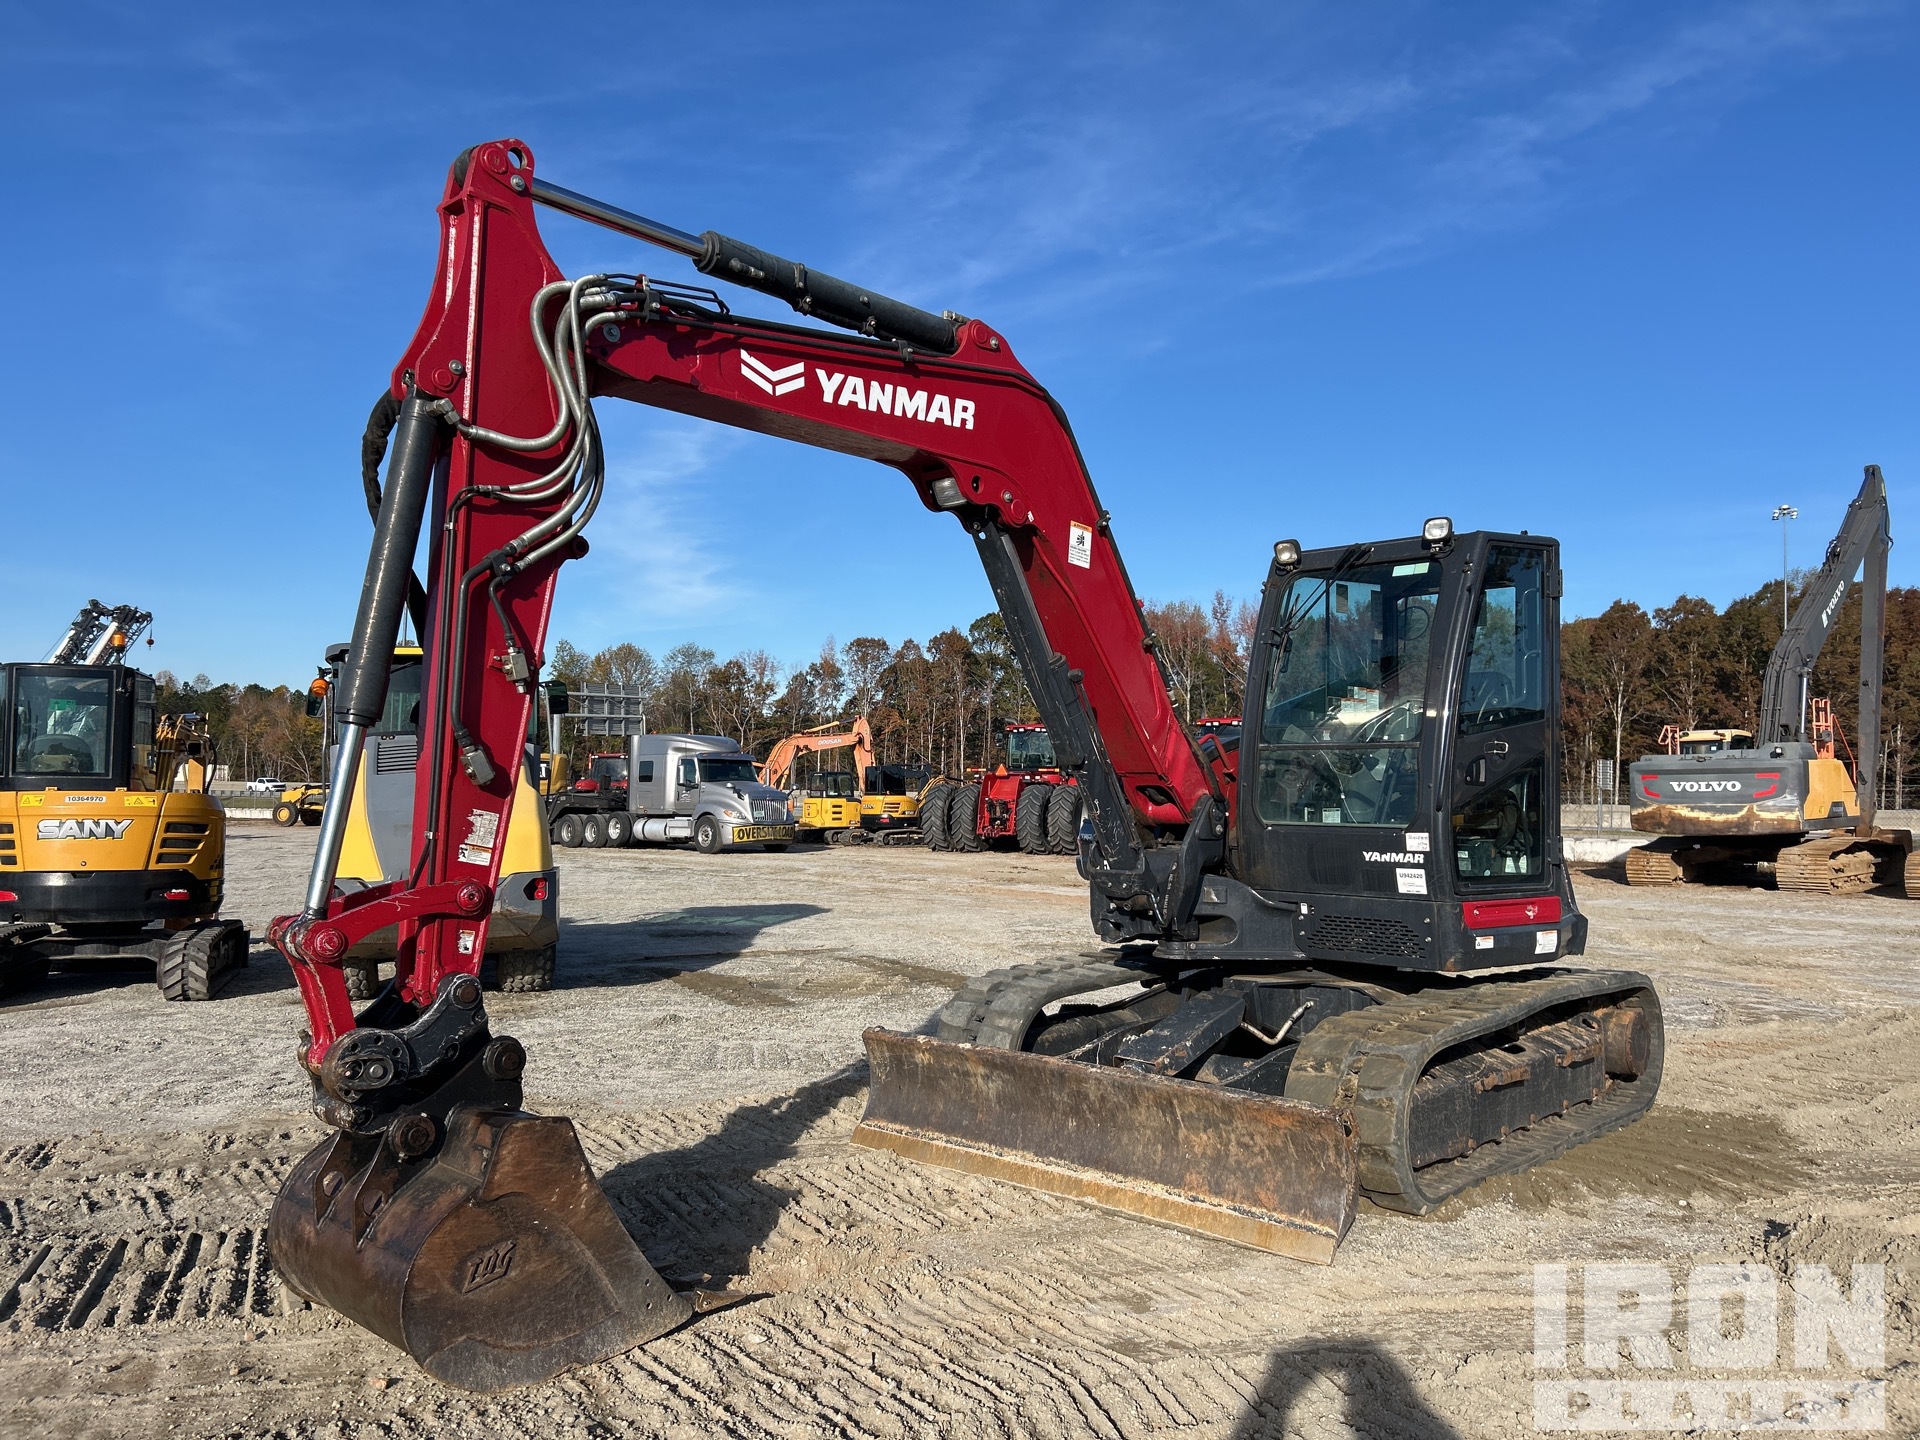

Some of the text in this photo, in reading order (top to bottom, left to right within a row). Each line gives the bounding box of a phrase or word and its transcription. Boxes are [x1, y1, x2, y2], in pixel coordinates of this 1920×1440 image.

[815, 368, 976, 430] YANMAR
[1826, 580, 1845, 616] VOLVO
[817, 738, 842, 746] DOOSAN
[1669, 781, 1742, 792] VOLVO
[37, 819, 134, 840] SANY
[1362, 851, 1424, 864] YANMAR
